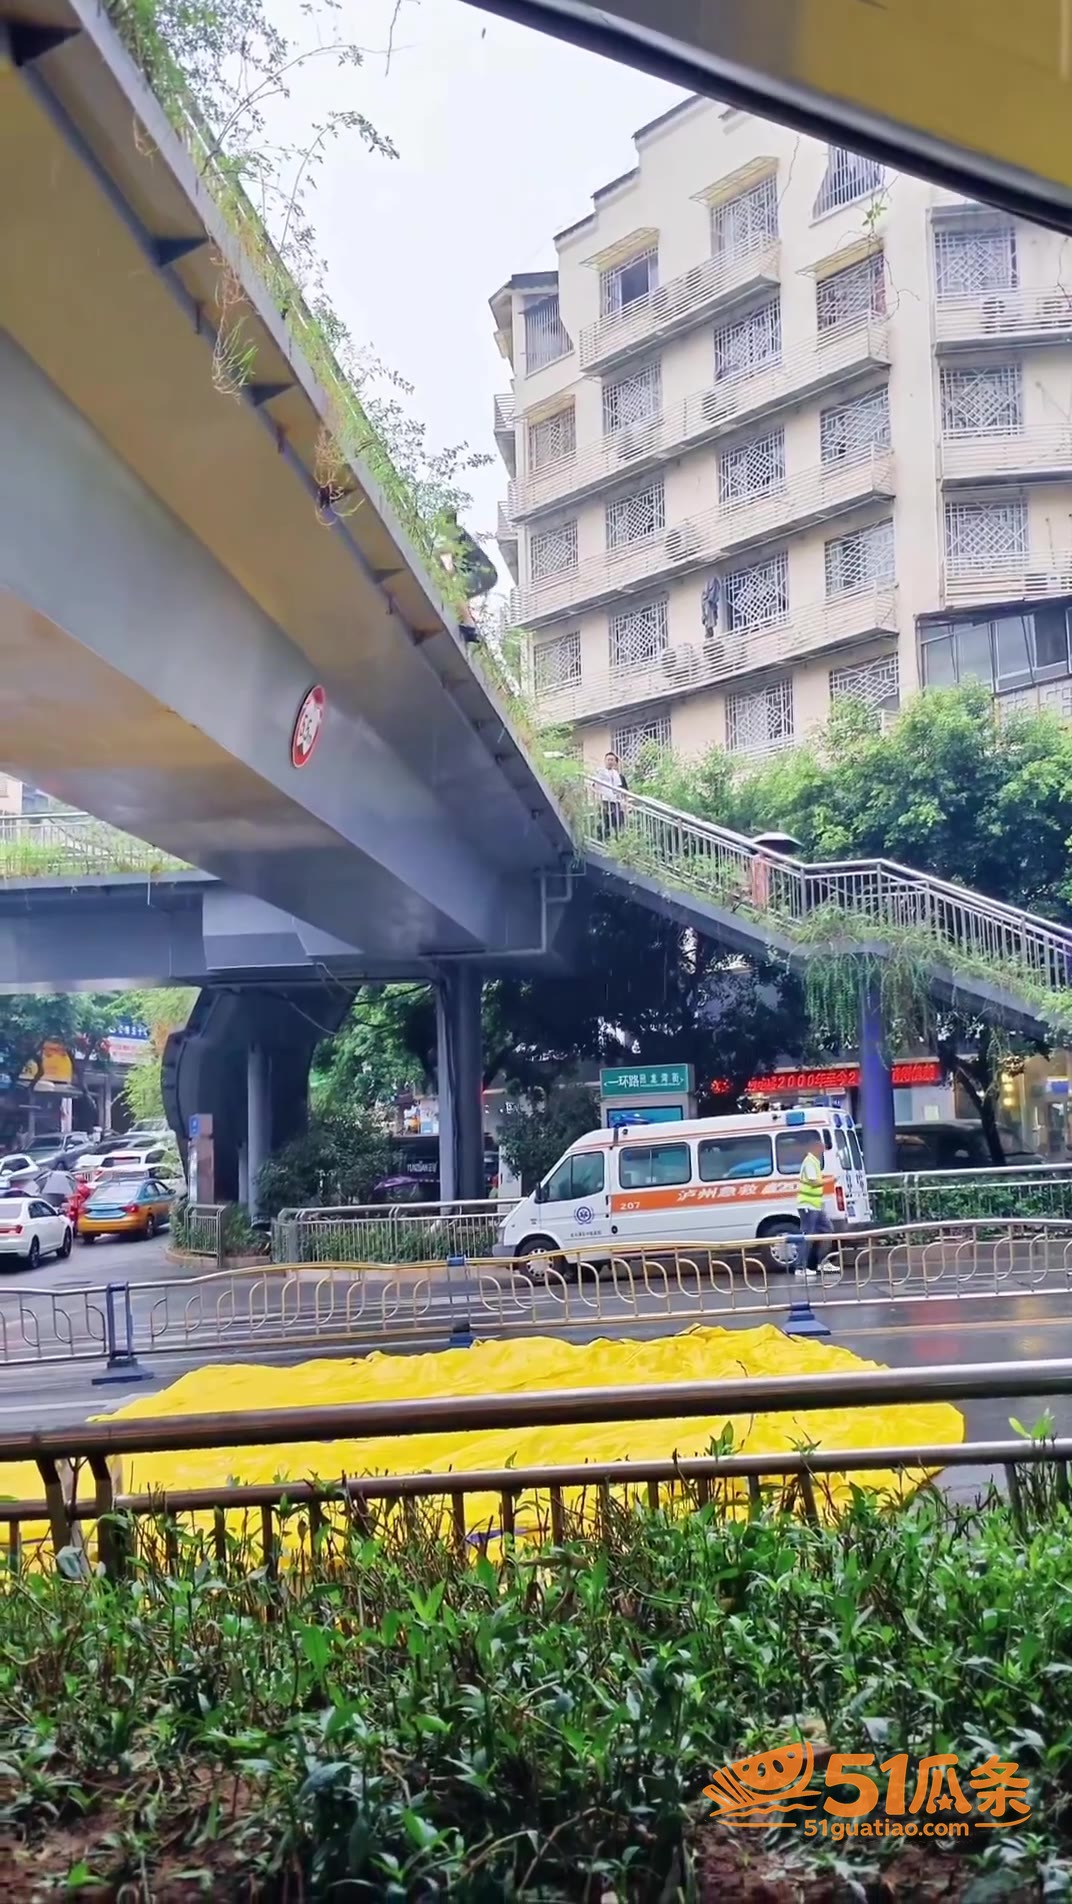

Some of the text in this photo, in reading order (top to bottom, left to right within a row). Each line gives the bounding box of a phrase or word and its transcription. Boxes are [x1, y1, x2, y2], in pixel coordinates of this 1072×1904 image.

[676, 1183, 759, 1202] 泸州急救
[619, 1201, 641, 1211] 207
